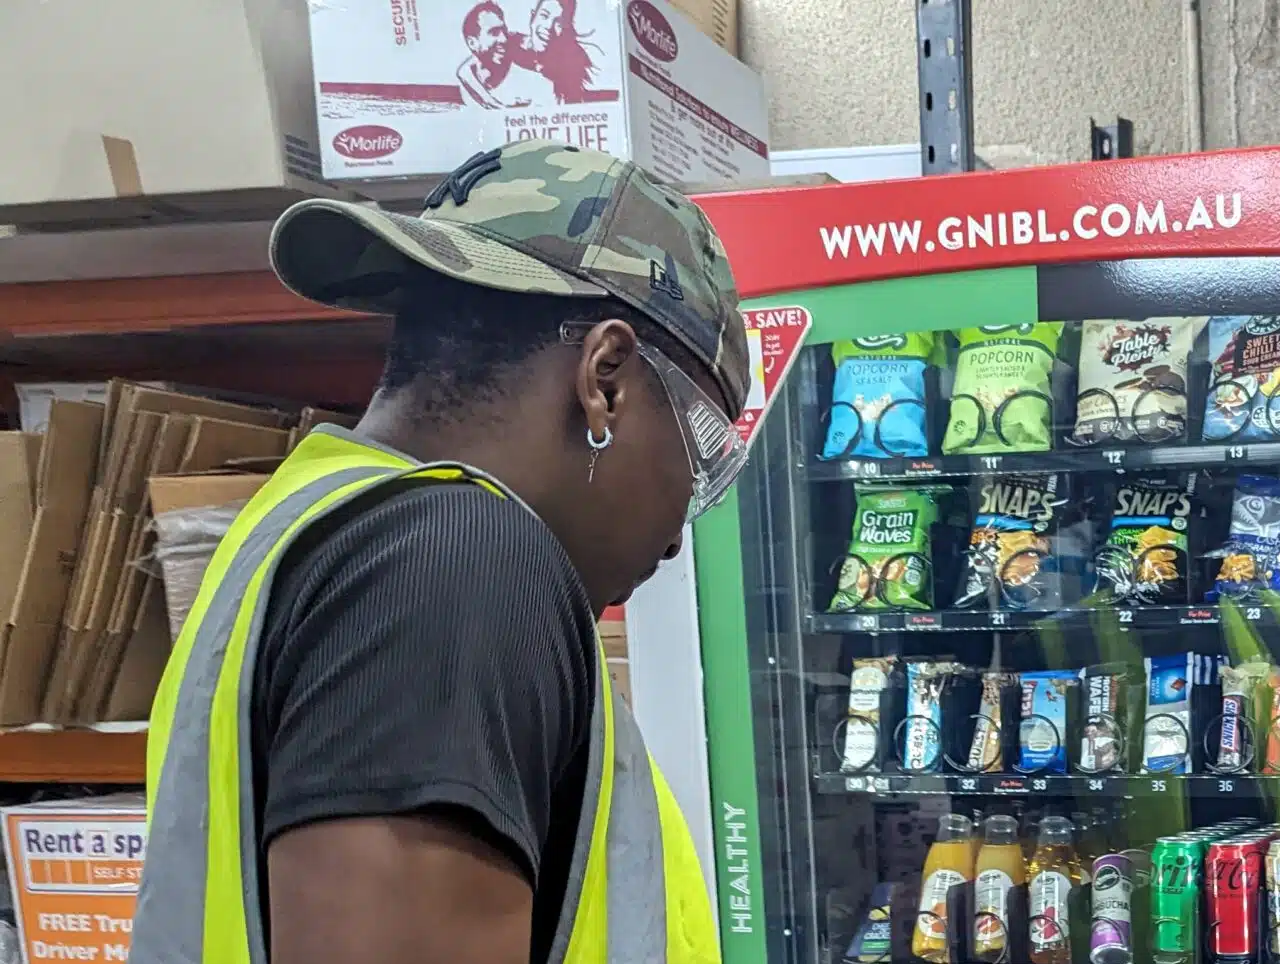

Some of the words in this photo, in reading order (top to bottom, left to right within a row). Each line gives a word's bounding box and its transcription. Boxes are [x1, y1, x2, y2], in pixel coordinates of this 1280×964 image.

[504, 115, 526, 127] feel
[530, 114, 548, 126] the
[551, 112, 608, 125] difference
[349, 134, 400, 152] Morlife
[819, 193, 1243, 260] WWW.GNIBL.COM.AU
[756, 309, 802, 328] SAVE!
[1112, 333, 1160, 353] Table
[1246, 334, 1280, 349] SWEET
[970, 351, 1034, 365] POPCORN
[1111, 345, 1167, 366] Plenty
[1243, 343, 1274, 359] CHILLI
[848, 363, 909, 375] POPCORN
[1108, 452, 1121, 464] 12
[1230, 447, 1243, 458] 13
[864, 463, 876, 474] 10
[986, 459, 997, 469] 11
[978, 482, 1057, 521] SNAPS
[1114, 488, 1191, 517] SNAPS
[862, 510, 913, 526] Grain
[860, 527, 911, 544] Waves
[863, 617, 875, 627] 20
[992, 615, 1005, 624] 21
[1120, 611, 1132, 622] 22
[1247, 609, 1260, 620] 23
[1223, 701, 1236, 747] SNICKERS
[962, 780, 975, 789] 32
[1033, 779, 1046, 790] 33
[1089, 780, 1102, 790] 34
[1152, 781, 1166, 791] 35
[1219, 781, 1233, 791] 36
[26, 828, 83, 853] Rent
[92, 834, 105, 853] a
[114, 834, 143, 858] sp
[723, 802, 752, 933] HEALTHY
[38, 913, 92, 932] FREE
[94, 915, 132, 933] Tru
[32, 940, 99, 960] Driver
